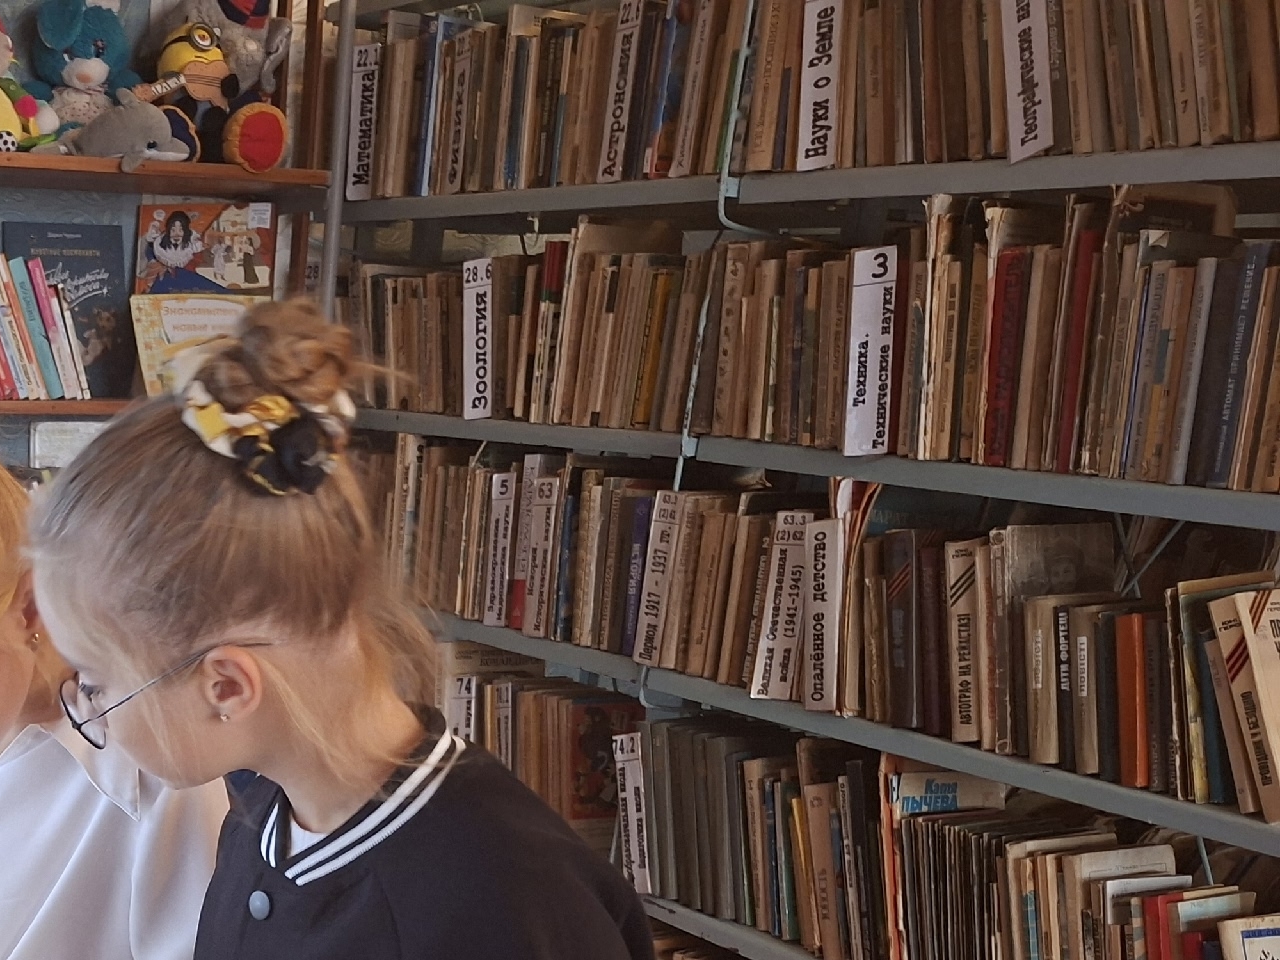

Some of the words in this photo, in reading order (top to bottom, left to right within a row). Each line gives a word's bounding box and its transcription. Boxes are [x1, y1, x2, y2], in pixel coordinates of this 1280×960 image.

[808, 6, 835, 68] Земле
[602, 30, 634, 177] Астрономия
[813, 76, 831, 89] о
[1018, 26, 1041, 146] Географические
[353, 69, 376, 187] Математика
[449, 71, 466, 184] Физика
[805, 98, 829, 160] Науки
[465, 263, 492, 284] 28.6
[872, 253, 888, 278] 3
[881, 286, 894, 335] науки
[472, 290, 488, 409] Зоология
[853, 333, 869, 407] Техника.
[872, 344, 891, 449] Технические
[499, 479, 509, 495] 5
[538, 483, 553, 499] 63
[783, 514, 806, 526] 63.3
[533, 549, 549, 632] Исторические
[543, 507, 552, 542] науки
[628, 543, 641, 595] ИСТОРИЯ
[652, 548, 669, 577] 1937
[813, 531, 827, 602] детство
[644, 592, 661, 621] 1917
[757, 647, 775, 697] Великая
[766, 548, 788, 641] Отечественная
[783, 564, 805, 638] (1941-1945)
[639, 622, 657, 661] Период
[811, 611, 825, 701] Опалённое
[1059, 611, 1069, 662] ФОРТЕЦІ
[456, 678, 471, 695] 74
[779, 647, 792, 683] война
[959, 661, 972, 679] НА
[1060, 664, 1069, 691] ДІТИ
[958, 682, 972, 725] АВТОГРАФ
[924, 778, 958, 795] Катя
